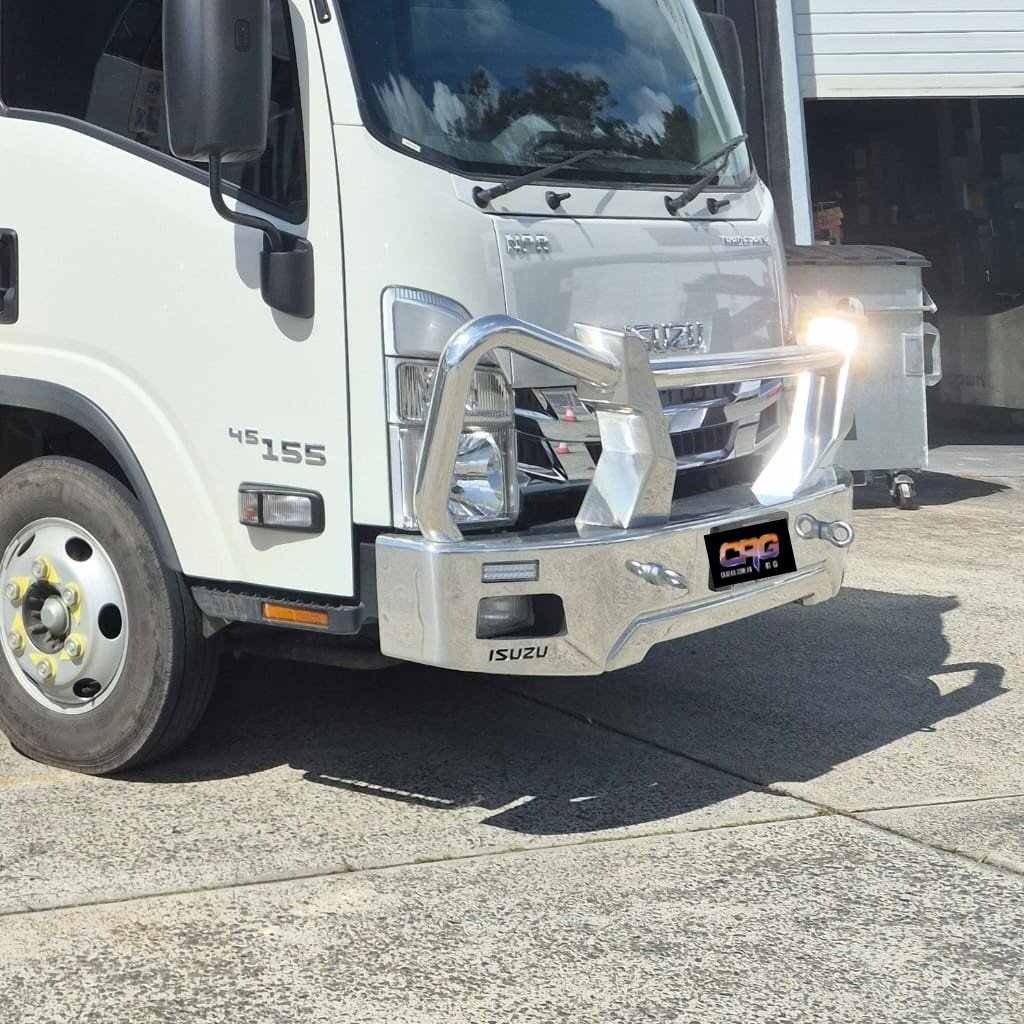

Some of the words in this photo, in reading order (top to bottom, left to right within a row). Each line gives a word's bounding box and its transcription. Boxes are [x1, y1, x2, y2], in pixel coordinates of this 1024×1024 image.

[228, 427, 259, 445] 45
[261, 438, 327, 467] 155
[488, 646, 549, 662] ISUZU
